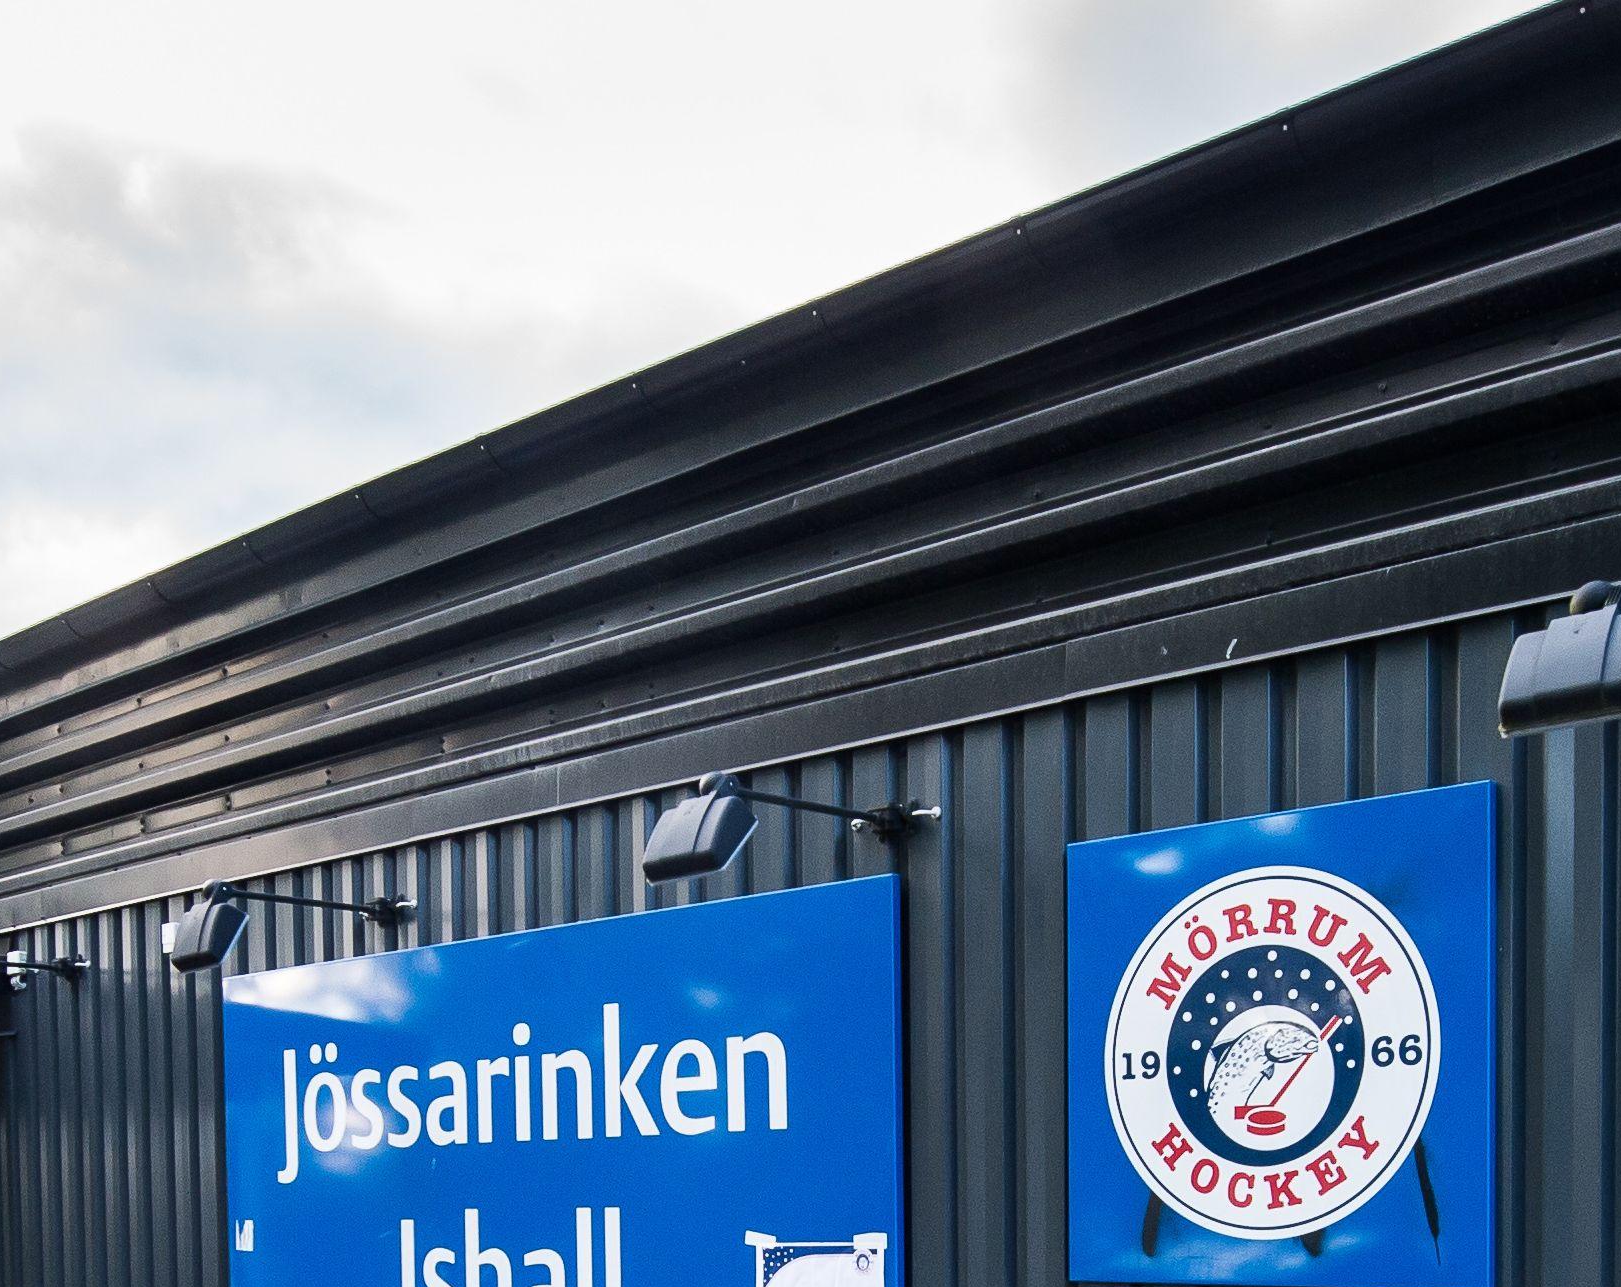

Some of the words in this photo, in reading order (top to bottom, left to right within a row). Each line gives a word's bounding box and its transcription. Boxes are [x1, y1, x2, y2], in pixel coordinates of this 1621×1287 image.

[1145, 898, 1391, 1010] MÖRRUM
[277, 1002, 788, 1184] Jössarinken
[1121, 1051, 1161, 1081] 19
[1371, 1034, 1423, 1067] 66
[1151, 1115, 1380, 1210] HOCKEY
